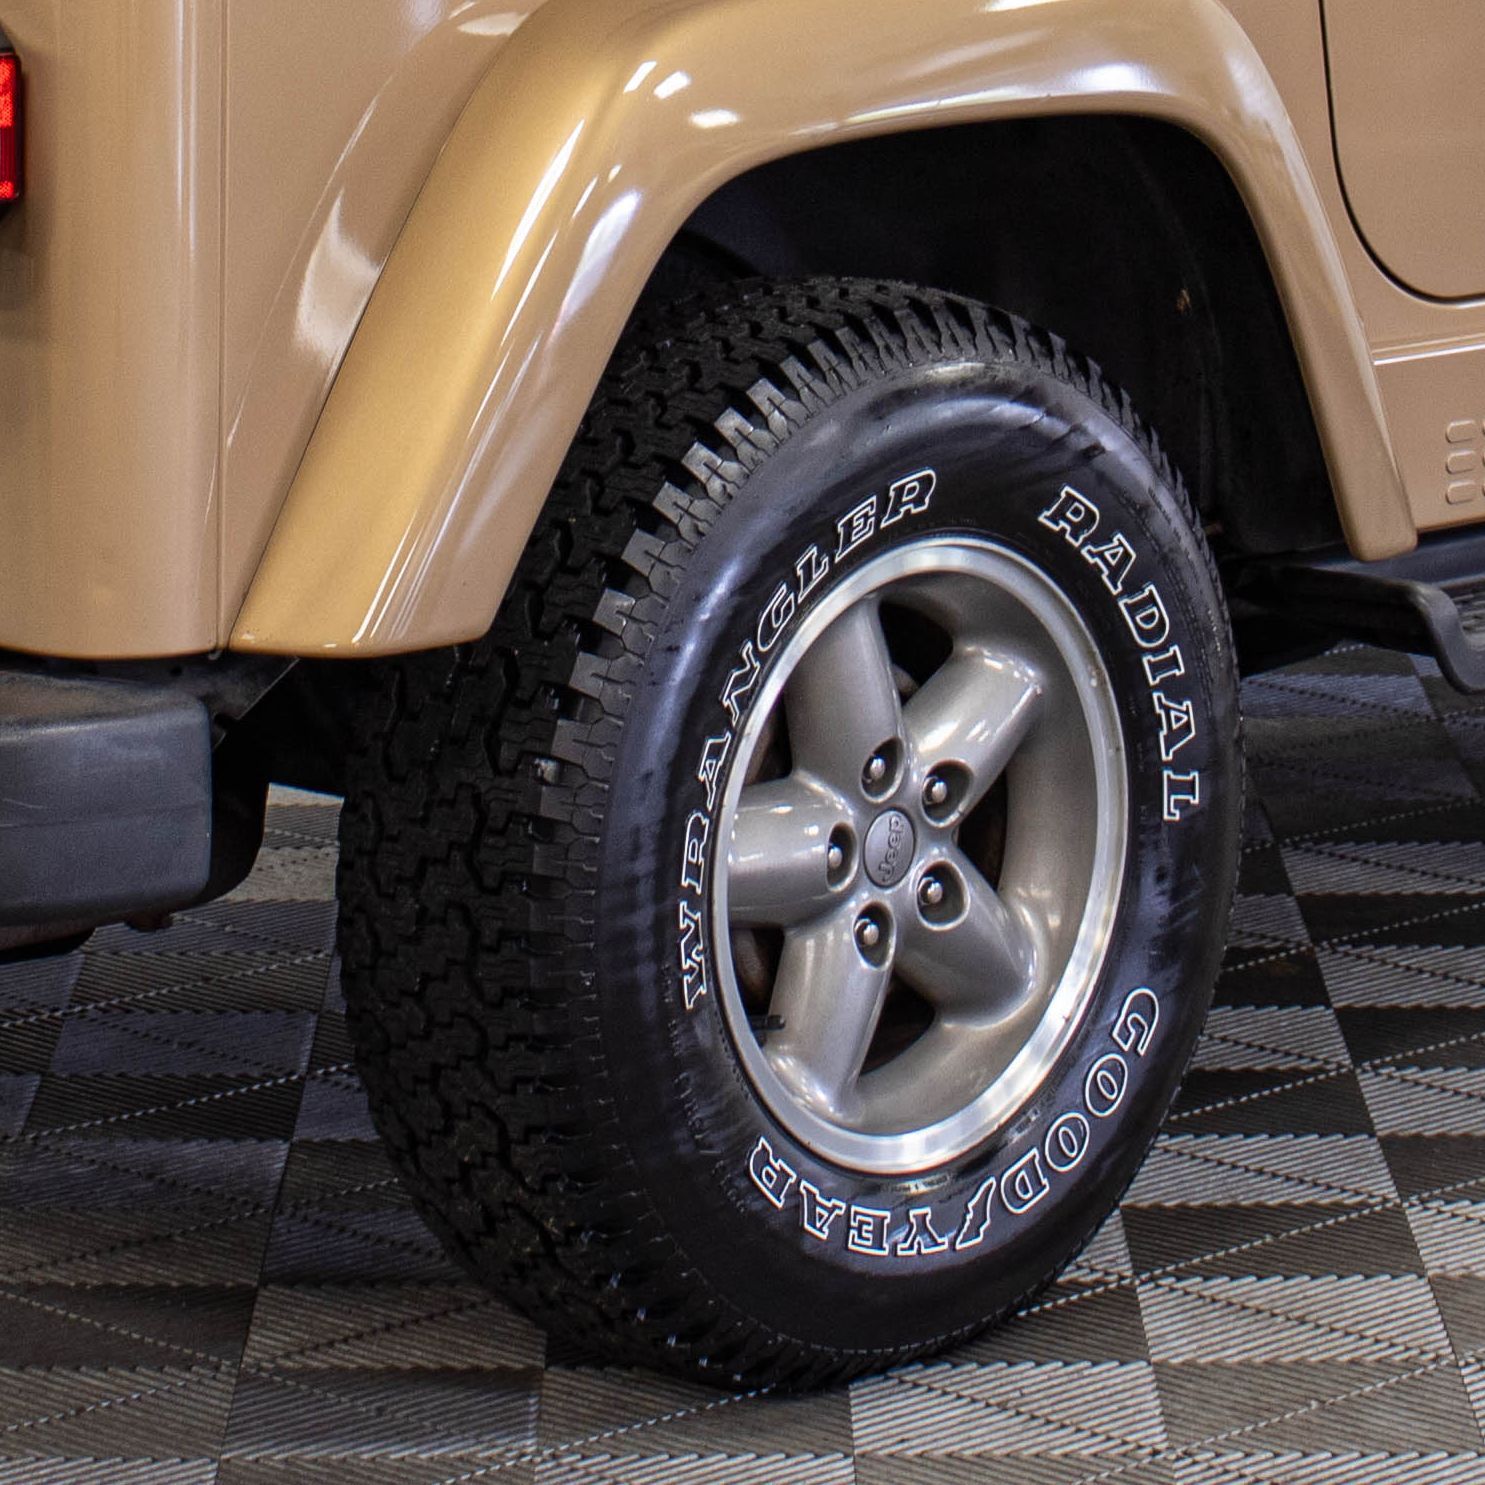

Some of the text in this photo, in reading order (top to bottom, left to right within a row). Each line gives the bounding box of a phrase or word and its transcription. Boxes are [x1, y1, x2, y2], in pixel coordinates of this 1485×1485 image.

[679, 467, 1202, 1010] WRANGLER RADIAL
[878, 813, 906, 884] Jeep
[748, 986, 1161, 1257] GOODYEAR
